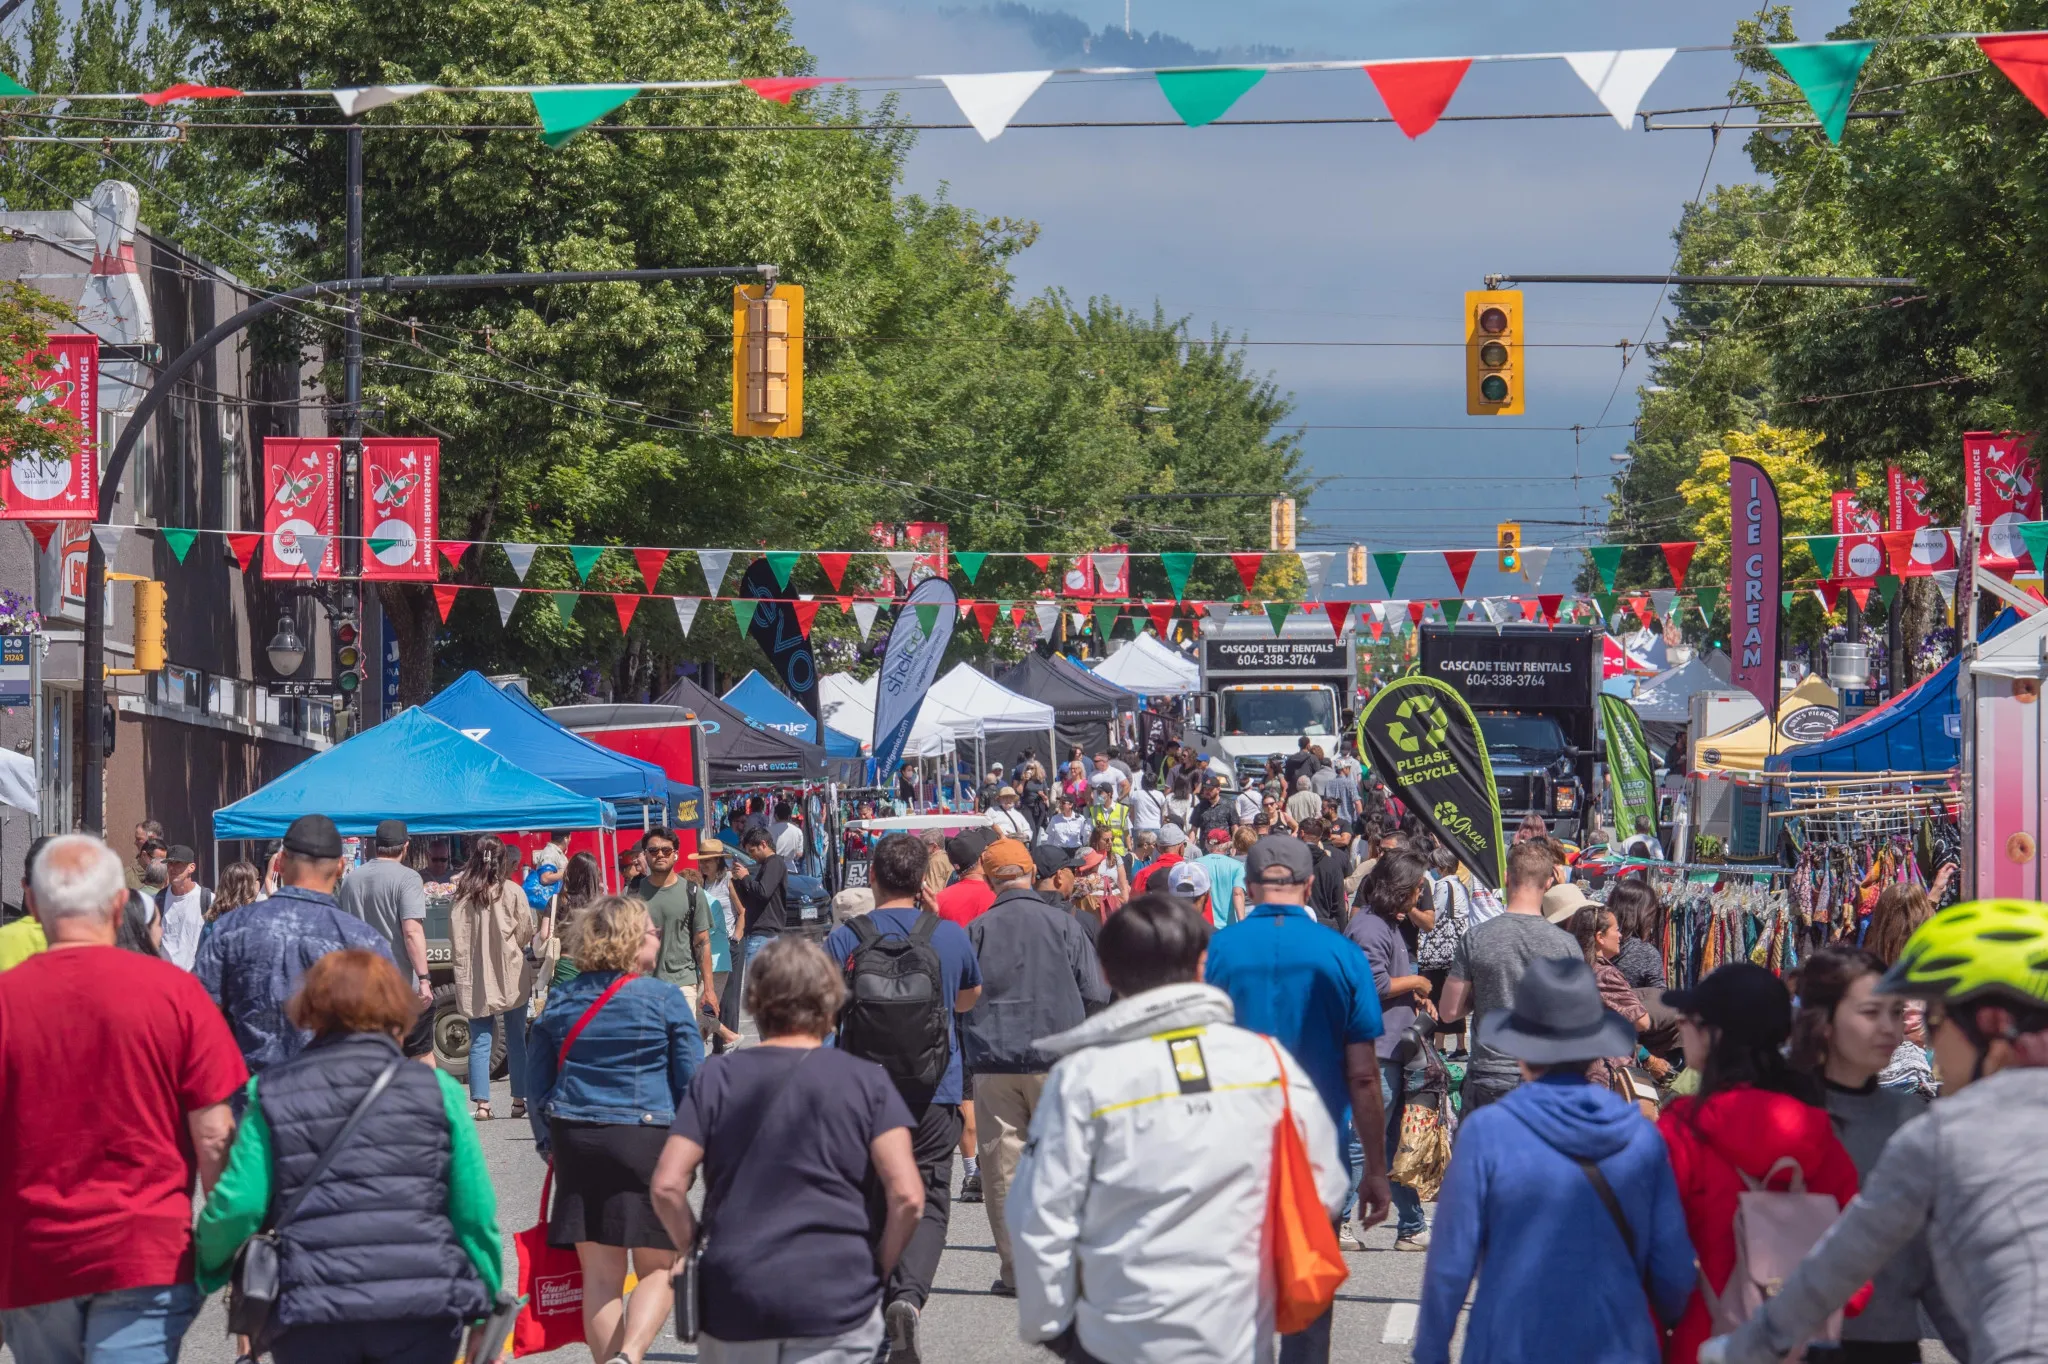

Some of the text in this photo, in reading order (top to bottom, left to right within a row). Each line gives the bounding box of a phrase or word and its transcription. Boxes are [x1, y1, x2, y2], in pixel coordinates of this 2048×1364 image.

[1895, 473, 1903, 530] RENAISSANCE
[1991, 533, 2022, 541] CONWE
[1742, 477, 1764, 668] ICE CREAM
[1219, 644, 1334, 653] CASCADE TENT RENTALS
[4, 653, 24, 661] 51243
[1237, 654, 1316, 666] 604-338-3764
[1440, 660, 1572, 673] CASCADE TENT RENTALS
[1466, 673, 1546, 687] 604-338-3764
[284, 685, 292, 694] E.
[294, 685, 305, 694] 6th
[882, 719, 909, 778] shelfgenie.com
[736, 761, 798, 772] Join at evo.ca
[1396, 749, 1451, 772] PLEASE
[1396, 763, 1459, 787] RECYCLE
